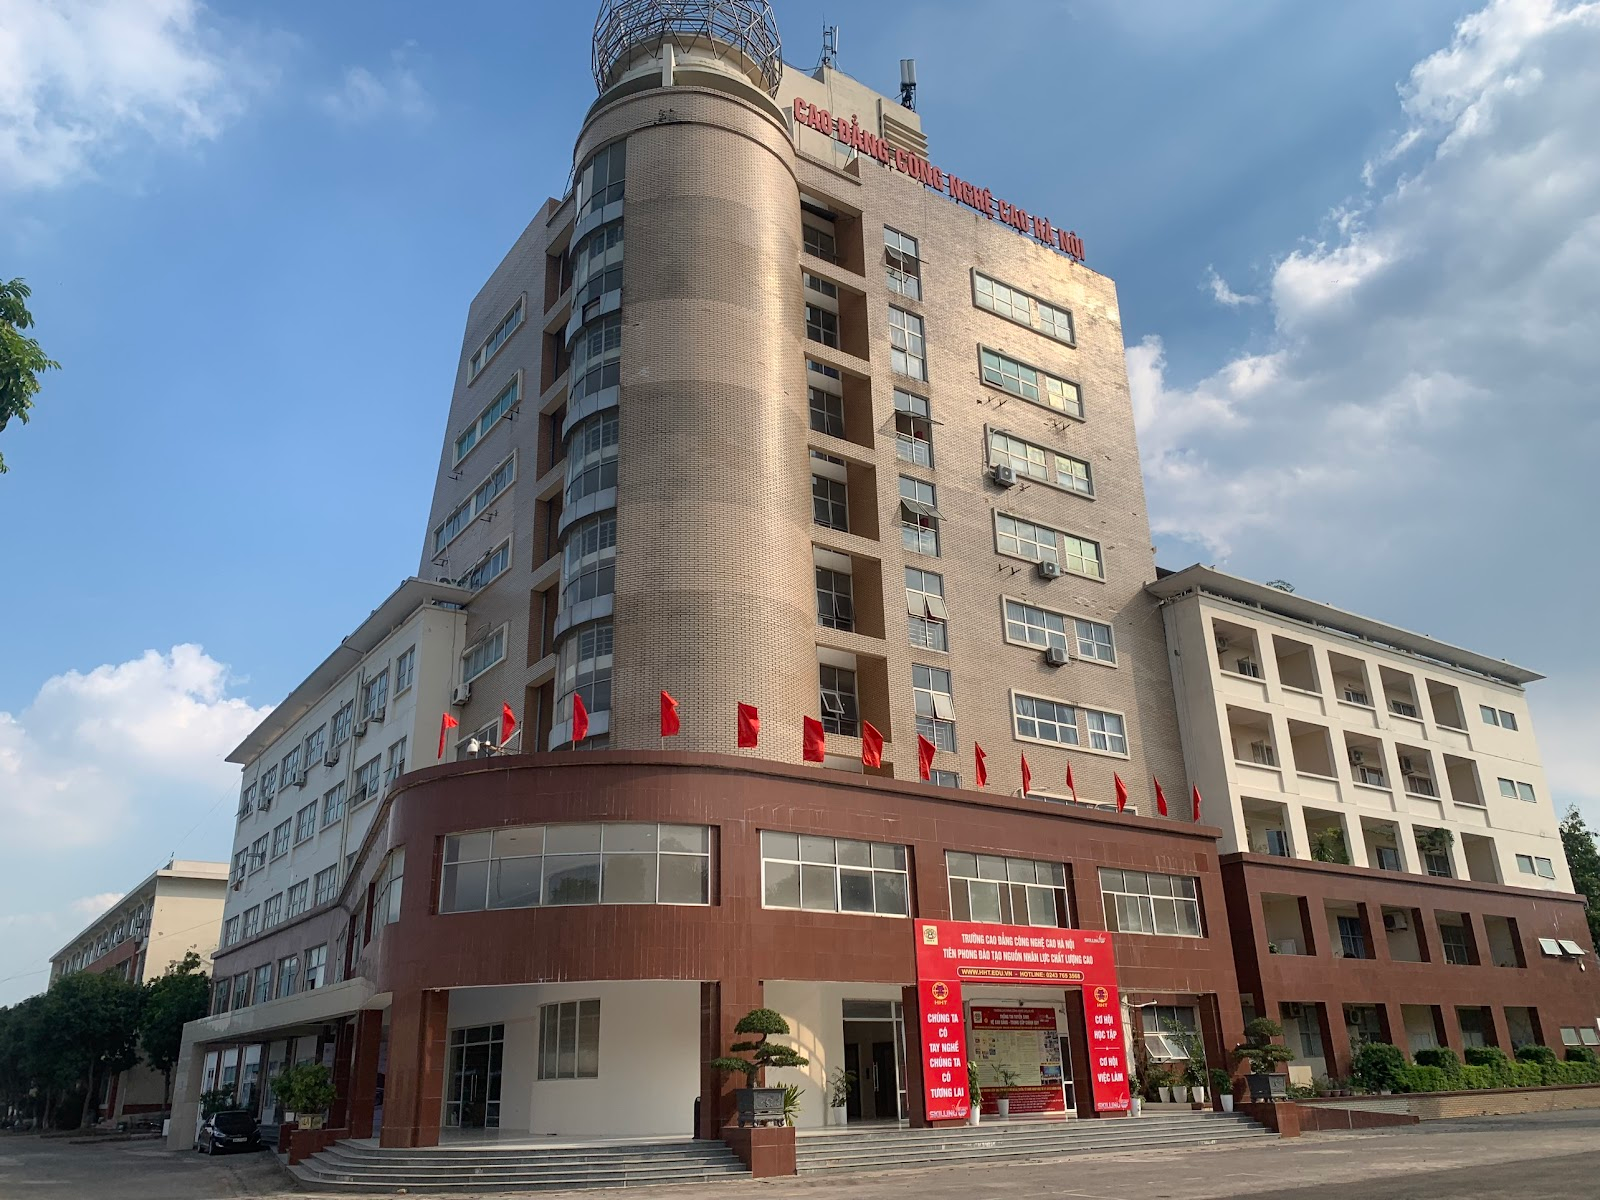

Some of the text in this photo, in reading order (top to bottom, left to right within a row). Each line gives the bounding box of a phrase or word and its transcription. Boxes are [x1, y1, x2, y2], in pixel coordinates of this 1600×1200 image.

[794, 97, 833, 136] CAO
[895, 150, 944, 192] CÔNG
[949, 173, 994, 220] NGHỆ
[998, 199, 1030, 233] CAO
[1033, 216, 1056, 247] HÀ
[1058, 230, 1086, 262] NỘI
[985, 934, 997, 945] CAO
[1014, 936, 1030, 948] CÔNG
[1030, 937, 1045, 950] NGHỆ
[1046, 938, 1056, 949] CAO
[1057, 938, 1066, 949] HÀ
[1066, 938, 1075, 951] NỘI
[957, 949, 978, 960] PHONG
[978, 948, 991, 961] ĐÀO
[991, 950, 1002, 962] TẠO
[1083, 955, 1094, 965] CAO
[961, 968, 1013, 977] WWW.HHT.EDU.VN
[927, 1011, 959, 1023] CHÚNG TA
[1094, 1014, 1114, 1026] CƠ HỘI
[938, 1026, 948, 1038] CÓ
[1094, 1029, 1117, 1041] HỌC TẬP
[929, 1043, 940, 1053] TAY
[929, 1056, 961, 1068] CHÚNG TA
[1099, 1056, 1118, 1067] CƠ HỘI
[941, 1071, 951, 1083] CÓ
[1097, 1072, 1124, 1085] VIỆC LÀM
[930, 1087, 964, 1098] TƯƠNG LAI
